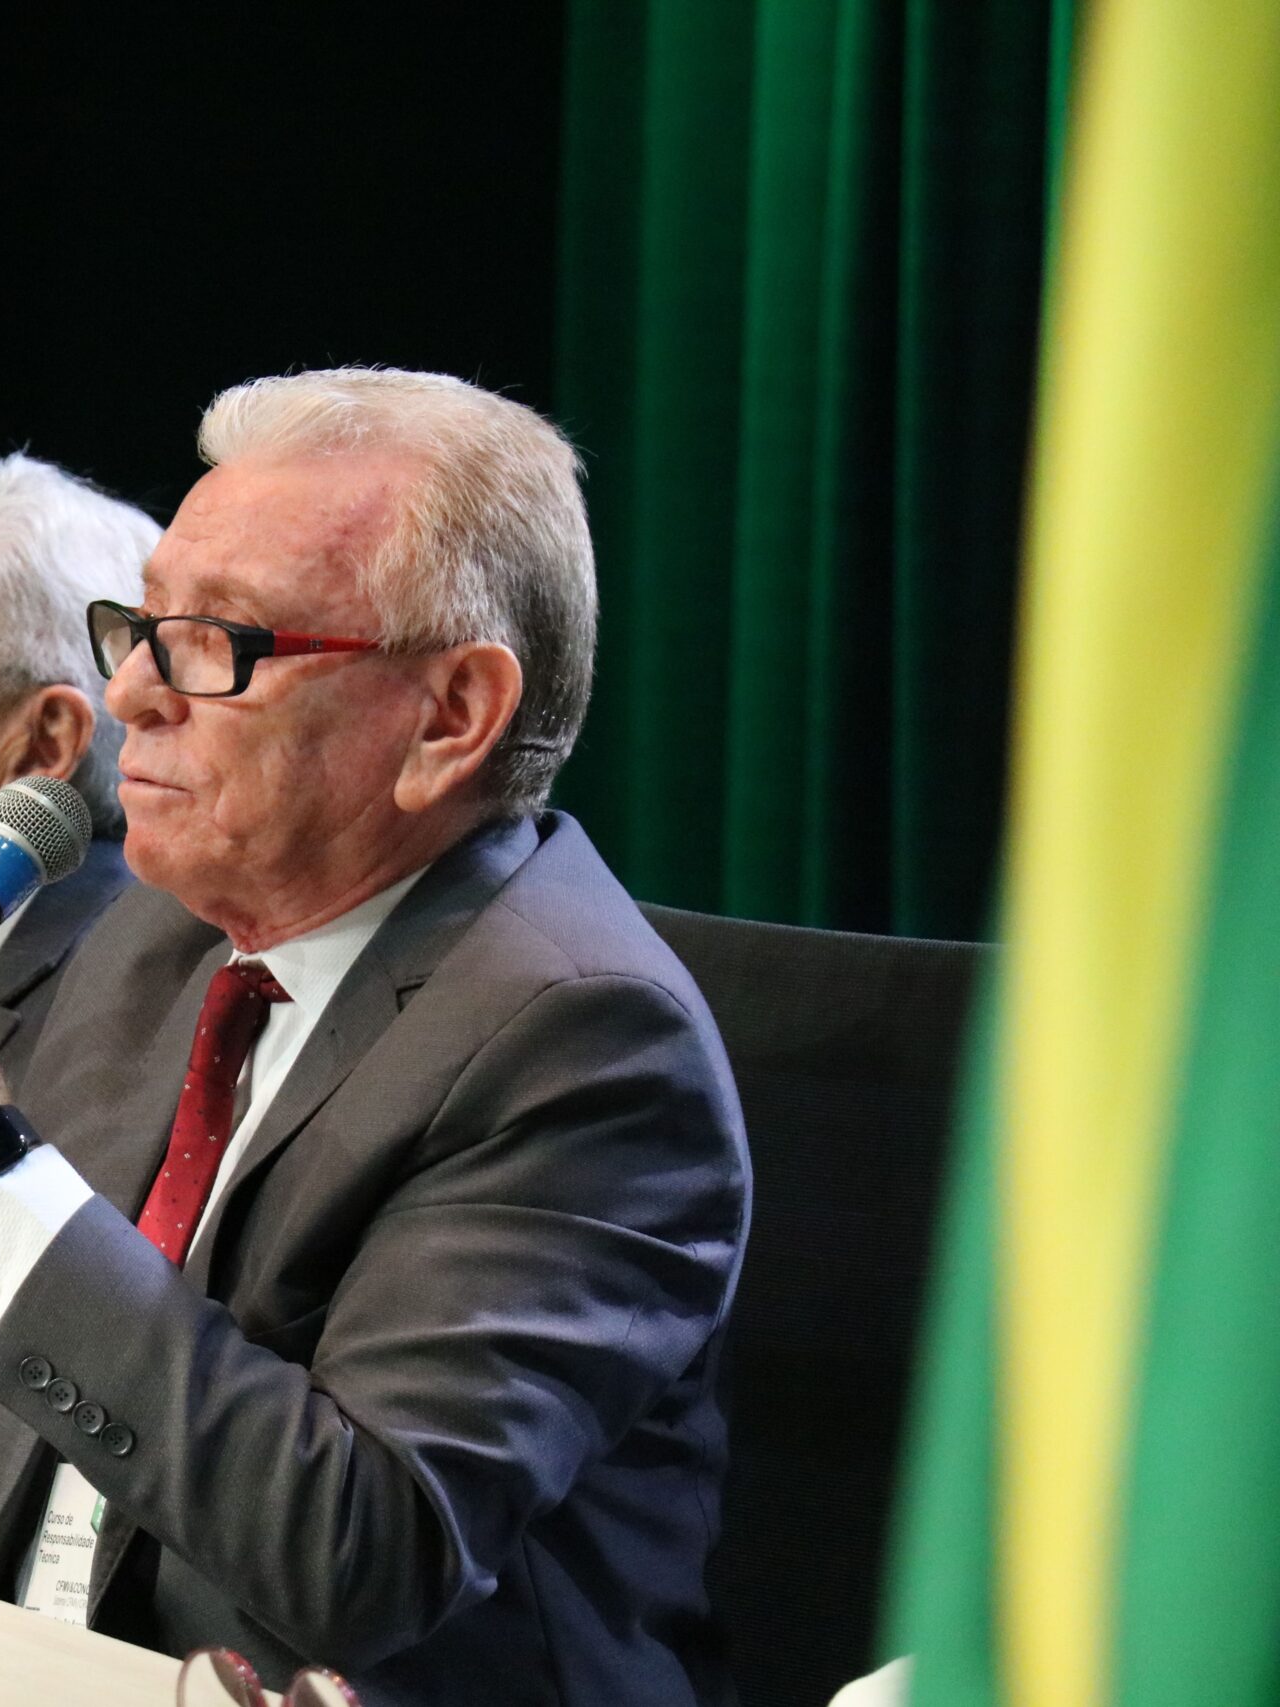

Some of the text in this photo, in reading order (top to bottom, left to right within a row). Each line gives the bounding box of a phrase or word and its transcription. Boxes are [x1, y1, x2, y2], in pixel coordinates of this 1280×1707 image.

[47, 1510, 74, 1526] Curso de
[42, 1530, 95, 1549] Responsabilidade
